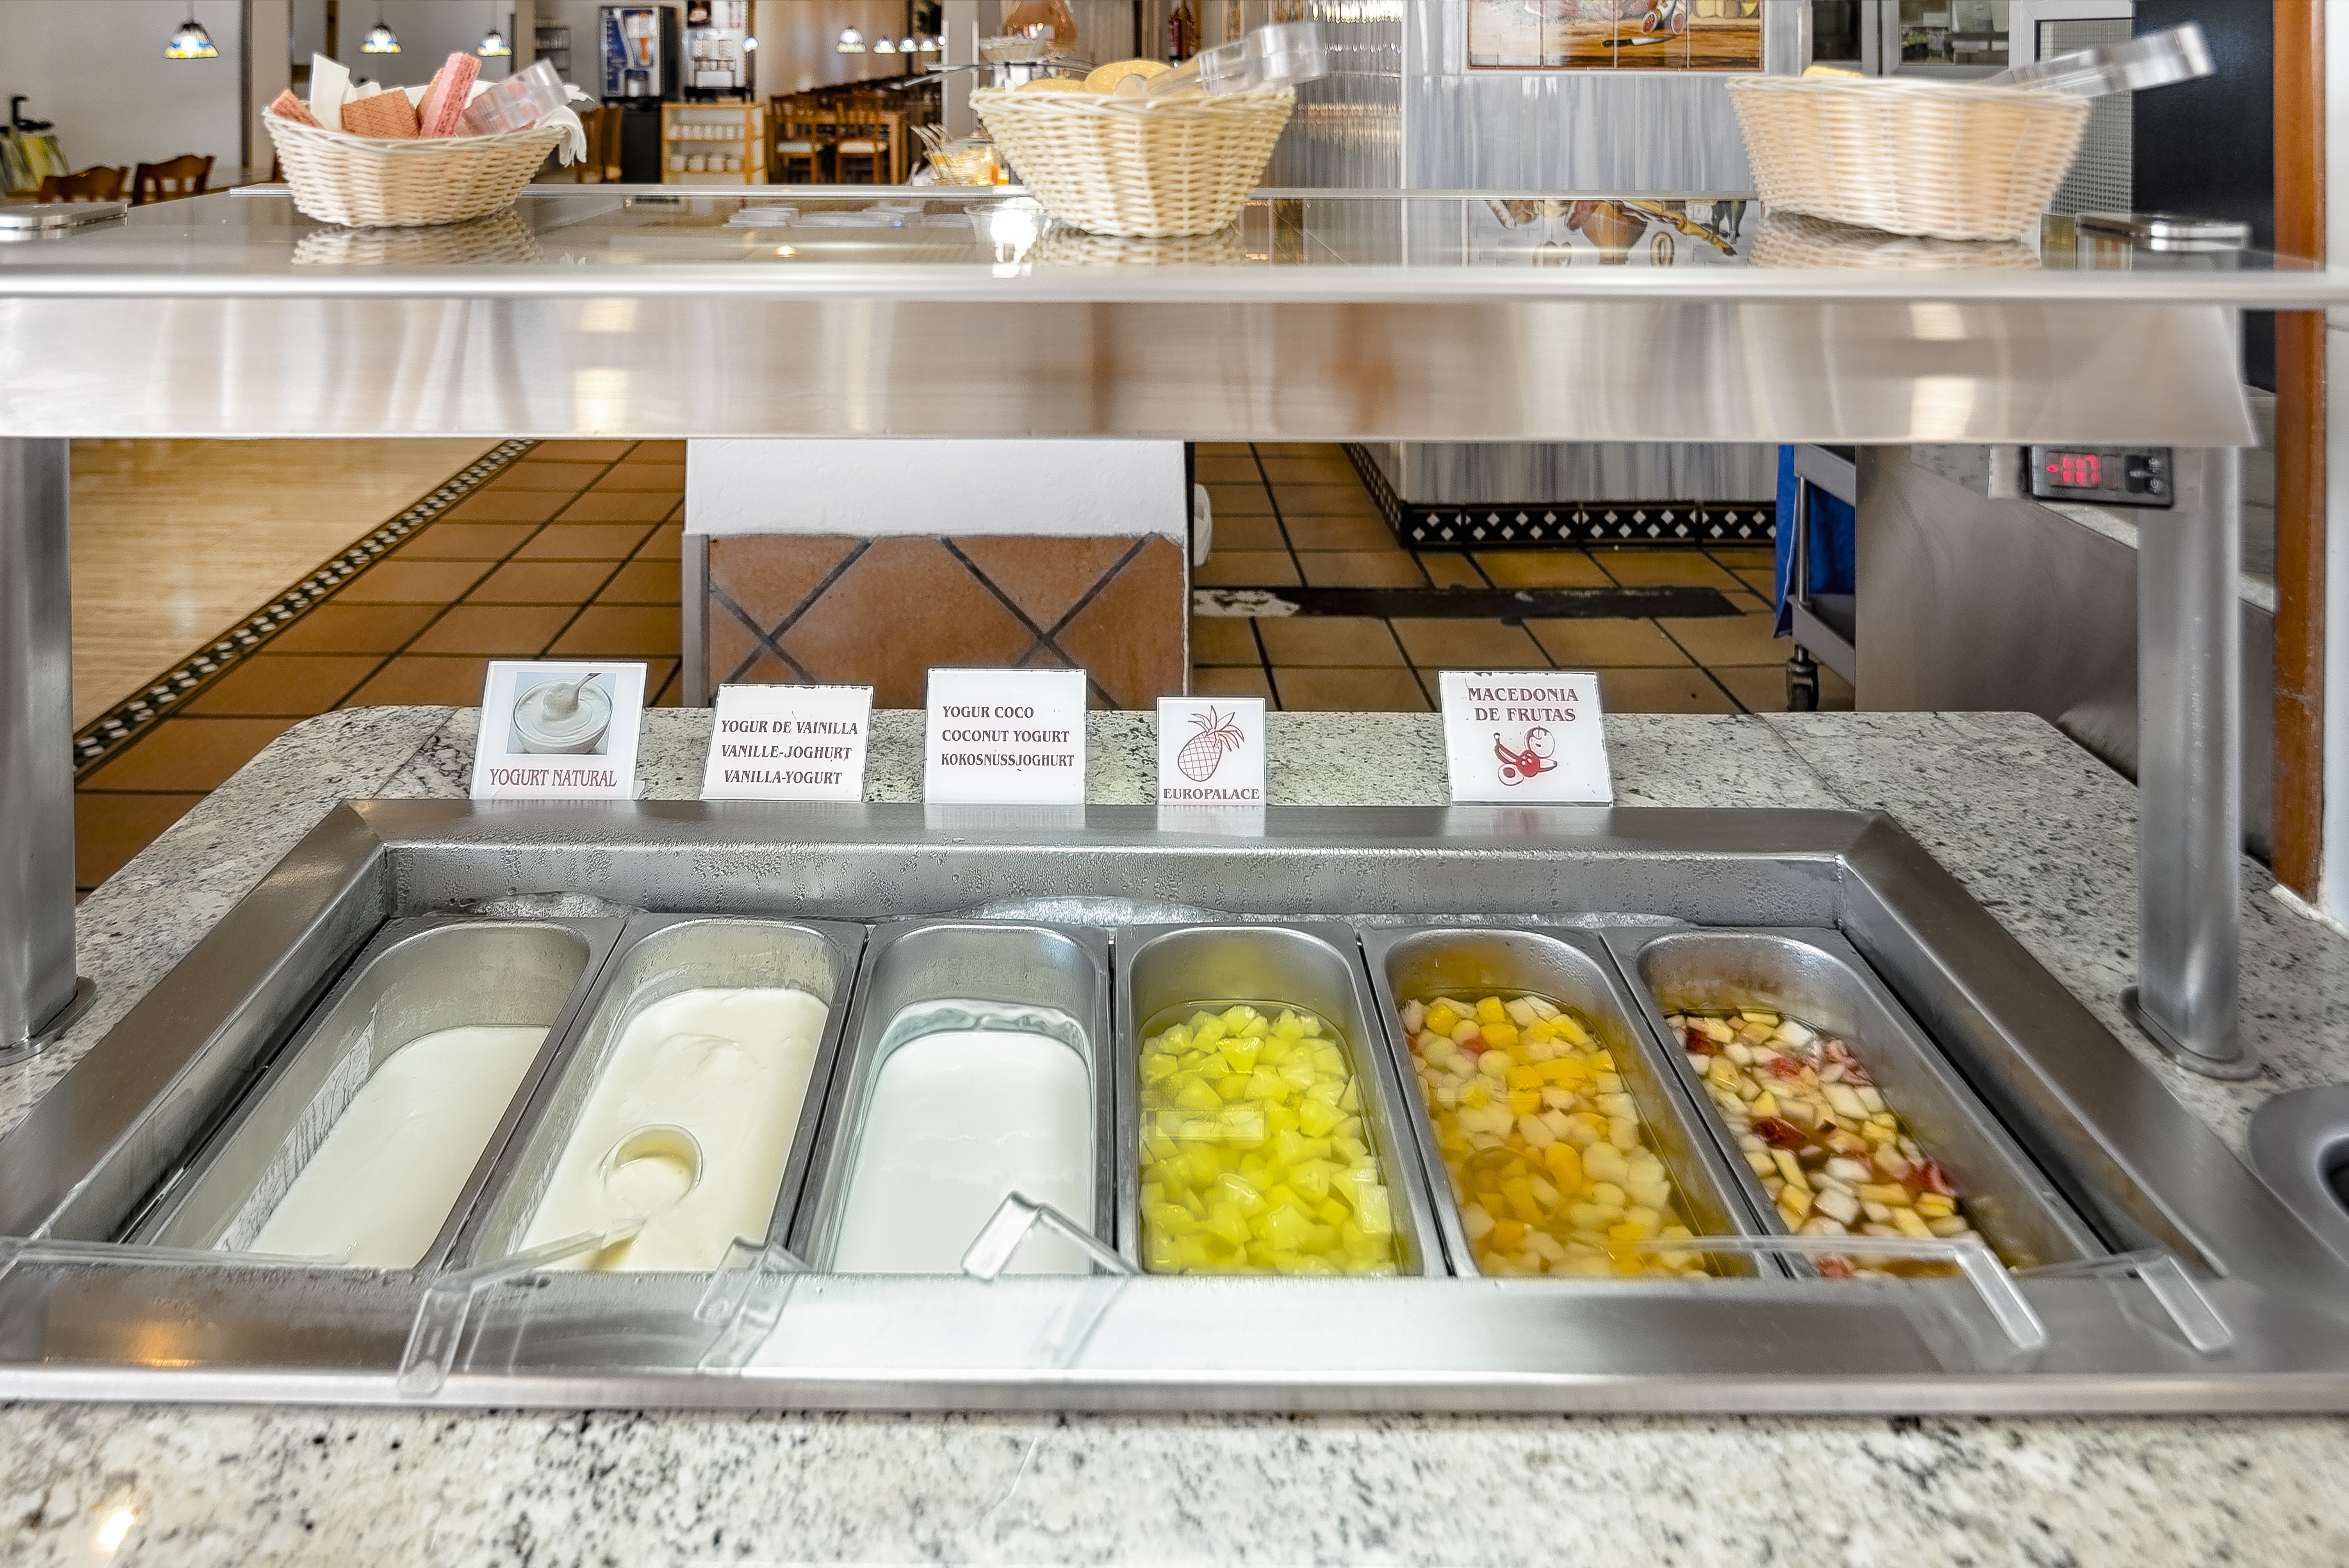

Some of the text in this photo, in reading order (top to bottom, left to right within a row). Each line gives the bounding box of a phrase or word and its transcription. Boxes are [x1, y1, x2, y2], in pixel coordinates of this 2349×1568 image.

[1468, 688, 1579, 701] MACEDONIA
[943, 706, 1034, 718] YOGUR COCO
[1474, 708, 1576, 722] DE FRUTAS
[722, 720, 858, 734] YOGUR DE VAINILLA
[942, 730, 1069, 742] COCONUT YOGURT
[722, 745, 852, 759] VANILLE-JOGHURT
[941, 754, 1075, 766] KOKOSNUSSJOGHURT
[490, 769, 617, 787] YOGURT NATURAL
[725, 770, 842, 784] VANILLA-YOGURT
[1164, 788, 1259, 800] EUROPALACE
